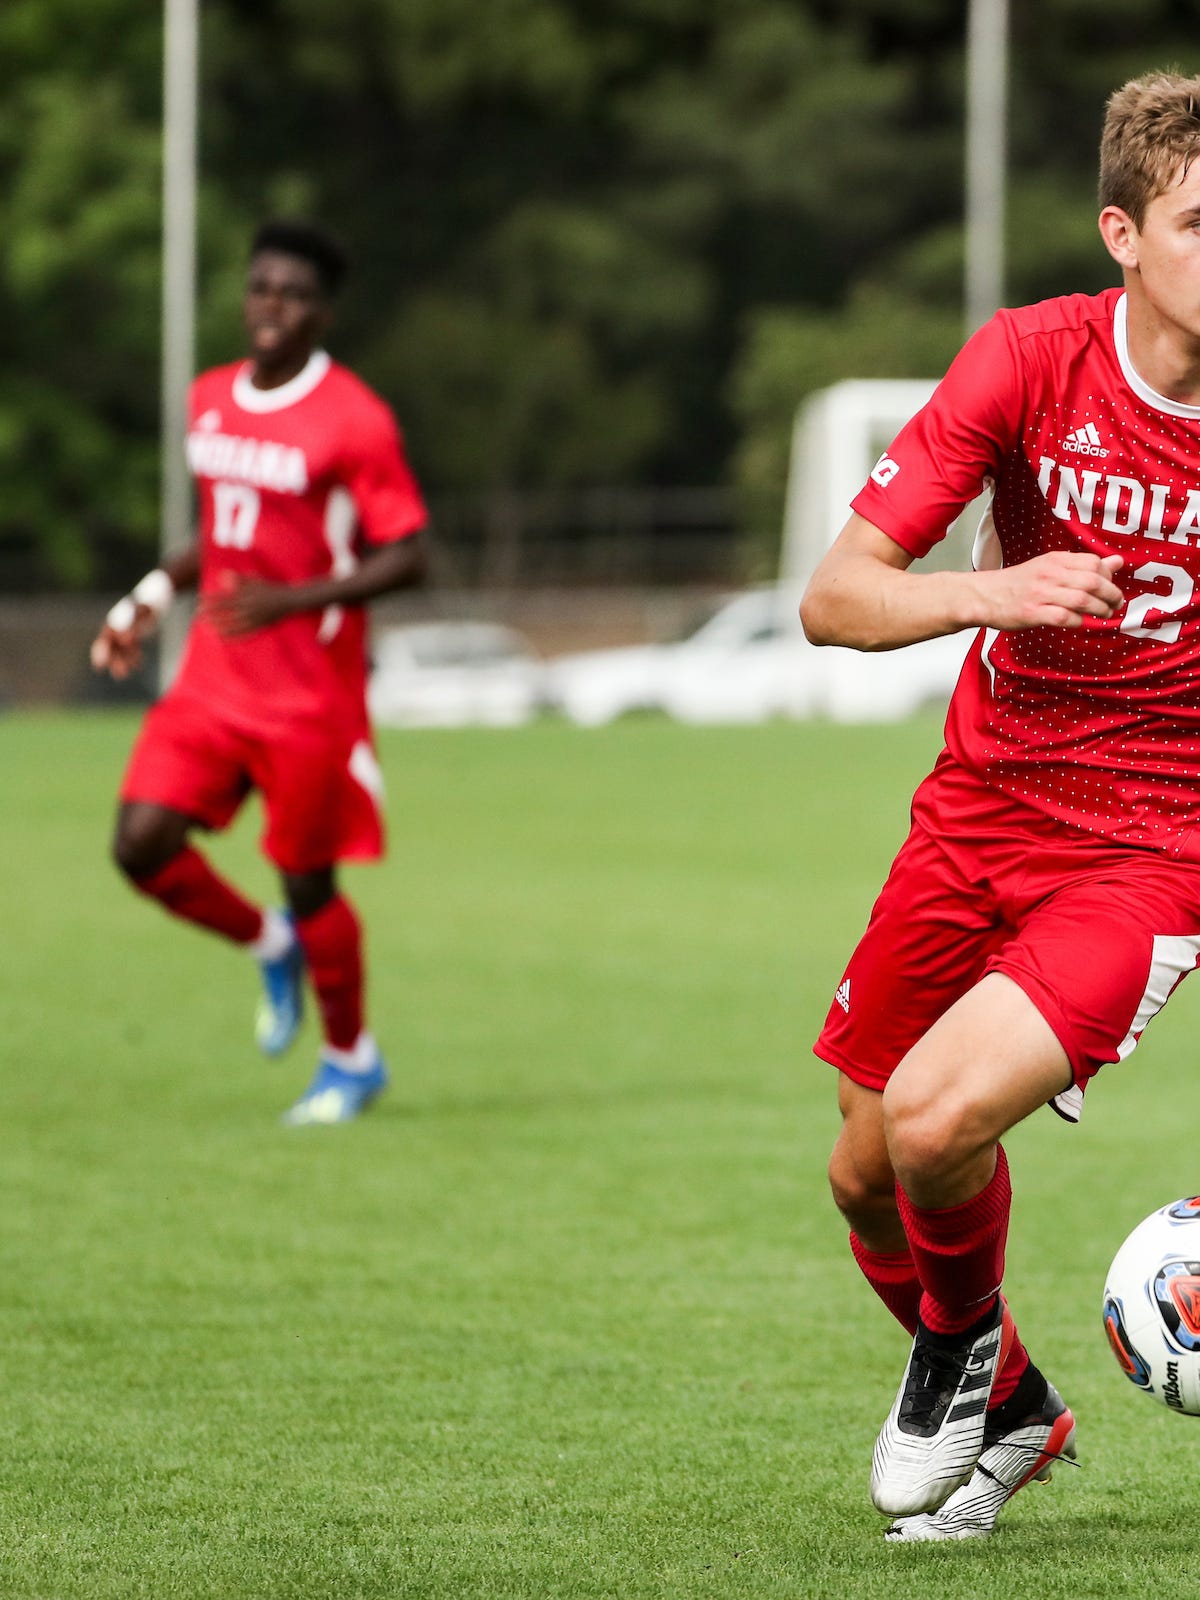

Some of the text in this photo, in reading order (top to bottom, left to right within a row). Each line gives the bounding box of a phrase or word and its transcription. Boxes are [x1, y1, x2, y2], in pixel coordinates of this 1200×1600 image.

[1062, 440, 1108, 458] adidas
[1119, 560, 1195, 644] 2
[1162, 1361, 1184, 1409] Wilson
